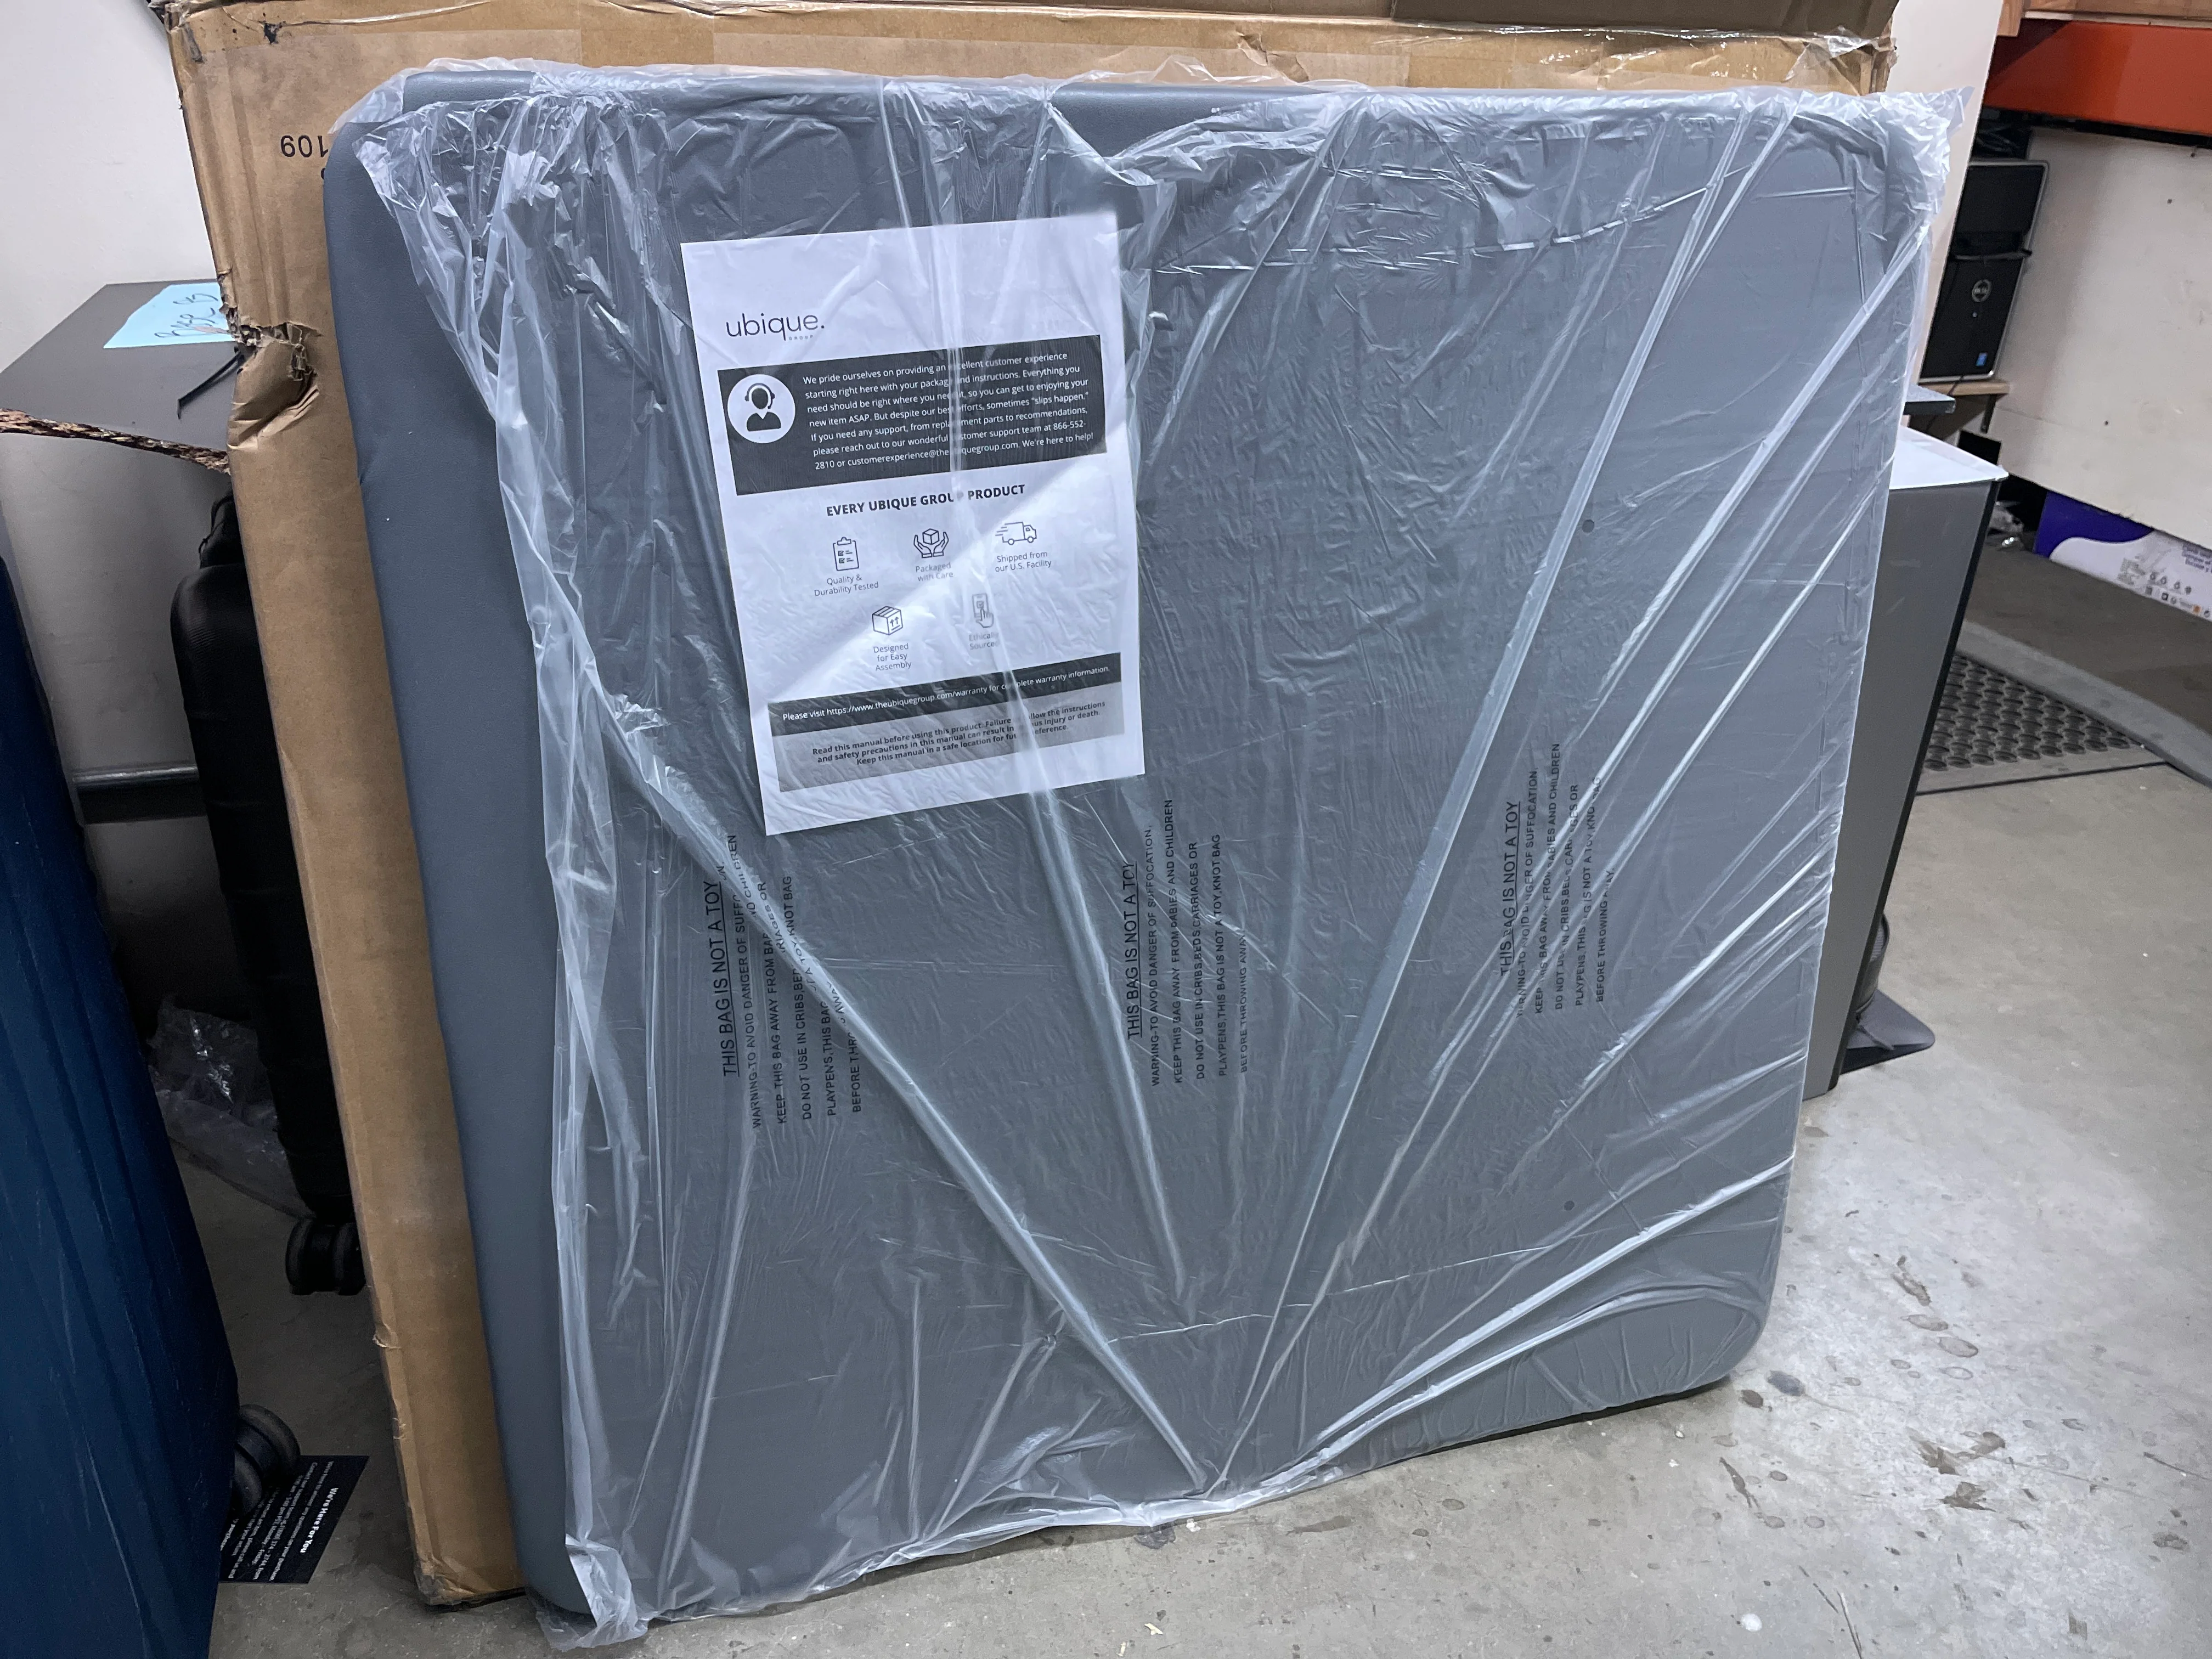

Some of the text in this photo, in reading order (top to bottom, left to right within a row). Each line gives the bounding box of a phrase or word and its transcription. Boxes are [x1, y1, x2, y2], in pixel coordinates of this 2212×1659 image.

[280, 135, 329, 158] 109
[726, 312, 825, 341] ubique.
[803, 376, 817, 385] We
[819, 374, 840, 385] pride
[842, 370, 881, 381] ourselves
[896, 365, 934, 377] providing
[985, 358, 1022, 366] customer
[1024, 353, 1068, 364] experience
[805, 390, 837, 399] starting
[838, 386, 858, 397] right
[880, 383, 898, 391] with
[899, 382, 918, 391] your
[920, 377, 953, 389] packag
[956, 375, 970, 384] nd
[972, 372, 1020, 382] instructions.
[1023, 367, 1064, 378] Everything
[1065, 366, 1080, 375] you
[848, 414, 872, 423] ASAP.
[874, 413, 888, 421] But
[890, 410, 919, 419] despite
[937, 405, 954, 414] be
[956, 402, 984, 413] fforts,
[986, 399, 1029, 409] sometimes
[1031, 396, 1052, 405] "slips
[1053, 392, 1088, 404] happen."
[815, 460, 834, 470] 2810
[847, 441, 1019, 466] customerexperience@thequegroup.com.
[1022, 439, 1044, 447] We're
[1075, 432, 1093, 441] help!
[826, 502, 865, 516] EVERY
[868, 496, 917, 511] UBIQUE
[968, 484, 1025, 500] PRODUCT
[915, 562, 951, 573] Packaged
[997, 552, 1027, 563] Shipped
[1010, 562, 1024, 571] U.S.
[1026, 560, 1051, 568] Facility
[814, 581, 879, 596] Durability Tested
[826, 576, 854, 586] Quality
[873, 642, 909, 653] Designed
[969, 639, 1000, 650] Source
[875, 661, 912, 672] Assembly
[782, 712, 808, 721] Please
[1001, 678, 1034, 690] cplete
[1035, 674, 1066, 684] warranty
[1068, 667, 1110, 678] information.
[812, 746, 833, 755] Read
[852, 738, 882, 749] manual
[884, 735, 910, 744] before
[912, 731, 933, 740] using
[985, 718, 1011, 727] Failure
[1062, 702, 1105, 714] instructions
[1165, 800, 1174, 857] CHILDREN
[1505, 802, 1517, 833] TOY
[1189, 842, 1197, 859] OR
[1212, 834, 1220, 856] BAG
[1505, 837, 1516, 847] A
[1539, 936, 1547, 957] BAG
[1550, 744, 1559, 799] CHILDREN
[1504, 853, 1515, 883] NOT
[1526, 852, 1533, 866] OF
[1166, 861, 1175, 884] AND
[1503, 888, 1514, 901] IS
[1148, 912, 1156, 926] OF
[737, 938, 747, 953] OF
[1122, 861, 1139, 1040] THIS BAG IS NOT A TOY
[1171, 931, 1179, 962] FROM
[1215, 930, 1223, 951] NOT
[1596, 901, 1607, 1002] BEFORE THROWING
[1148, 930, 1157, 975] DANGER
[1216, 955, 1224, 964] IS
[1500, 941, 1511, 976] THIS
[703, 881, 737, 1076] THIS BAG IS NOT A TOY
[738, 957, 753, 1008] DANGER
[1216, 968, 1224, 990] BAG
[1149, 980, 1158, 1012] AVOID
[1555, 972, 1564, 1009] DO NOT
[1172, 1001, 1181, 1023] BAG
[1195, 999, 1203, 1009] IN
[744, 1013, 756, 1047] AVOID
[1173, 1027, 1181, 1051] THIS
[1195, 1039, 1204, 1060] NOT
[797, 1033, 812, 1119] DO NOT USE IN
[1174, 1055, 1182, 1083] KEEP
[1196, 1064, 1204, 1079] DO
[313, 1508, 329, 1525] Here
[306, 1526, 319, 1538] For
[299, 1539, 313, 1553] You
